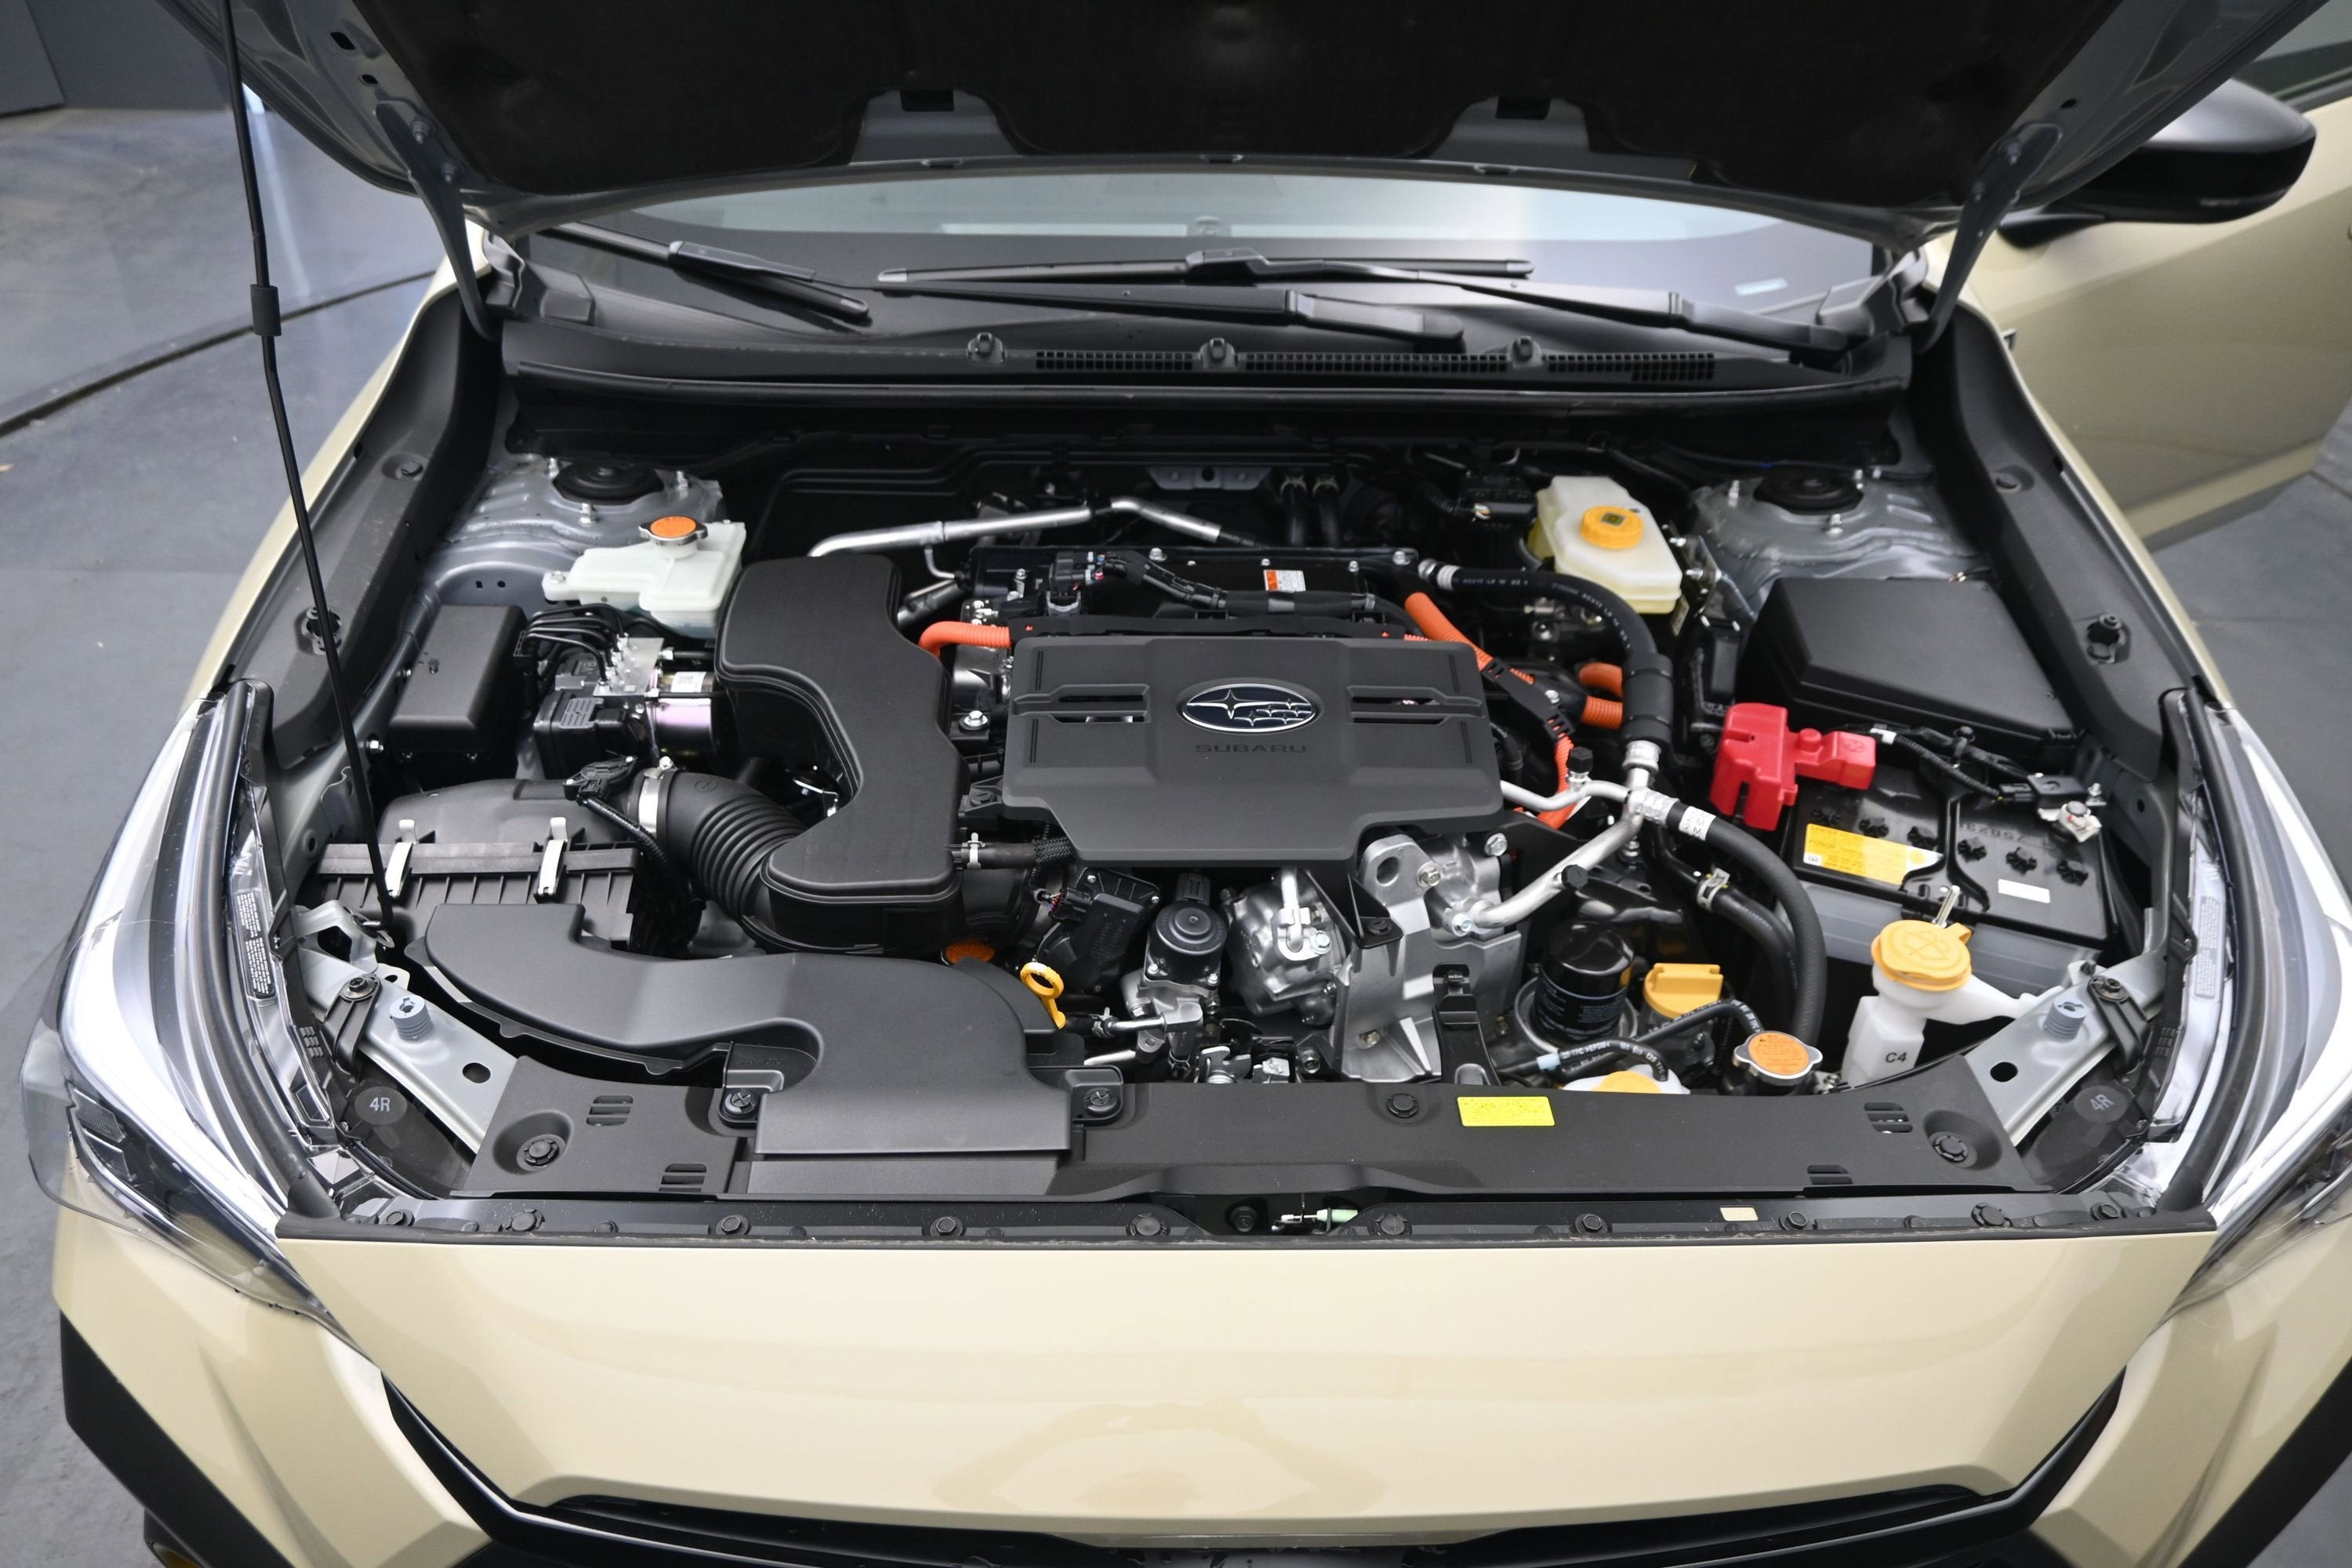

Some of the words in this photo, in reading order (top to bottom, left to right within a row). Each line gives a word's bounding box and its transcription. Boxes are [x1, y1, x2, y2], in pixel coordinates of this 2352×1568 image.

[1196, 744, 1307, 753] SUBARU
[1885, 1051, 1907, 1063] C4
[369, 1097, 390, 1112] 4R
[2090, 1094, 2114, 1110] 4R
